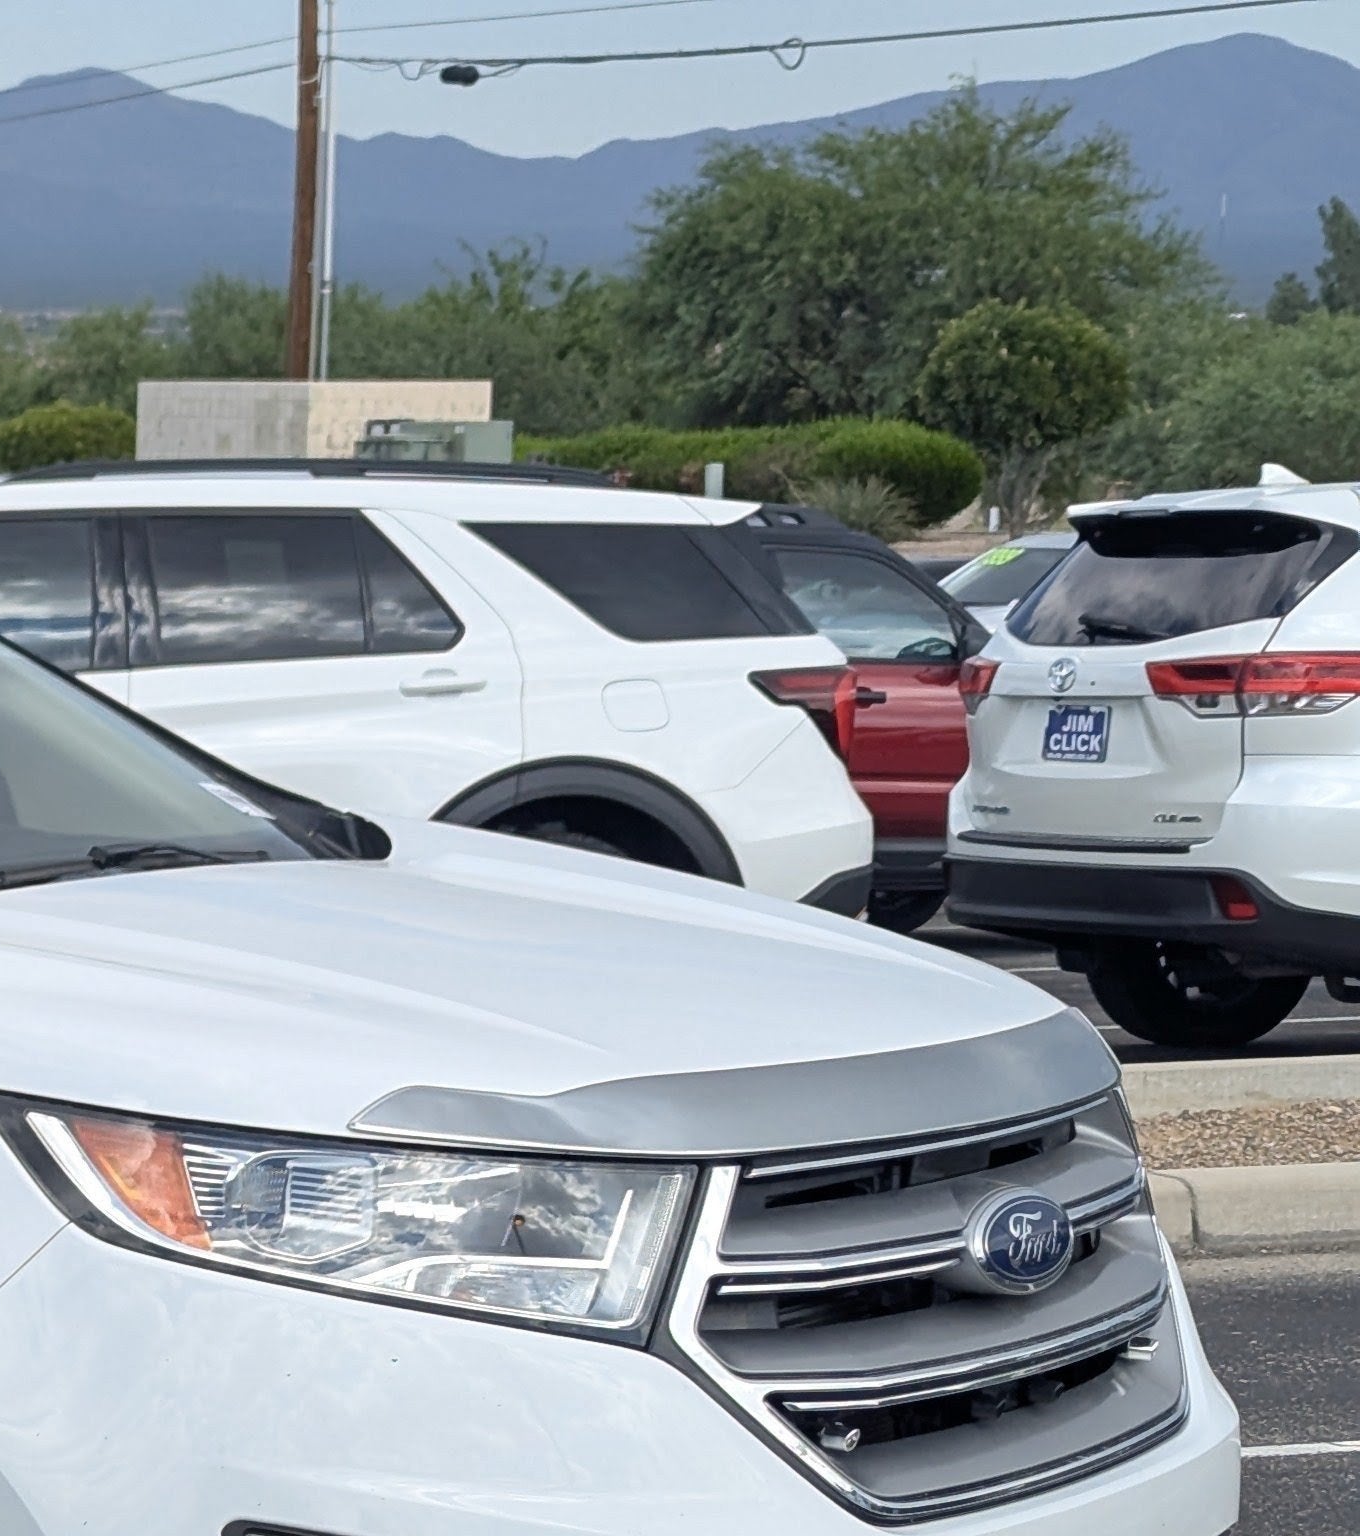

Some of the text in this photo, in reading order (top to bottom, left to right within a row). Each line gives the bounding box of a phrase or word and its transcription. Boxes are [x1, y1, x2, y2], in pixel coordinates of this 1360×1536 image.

[1061, 714, 1095, 732] JIM
[1049, 733, 1102, 752] CLICK
[1008, 1210, 1062, 1267] Ford
